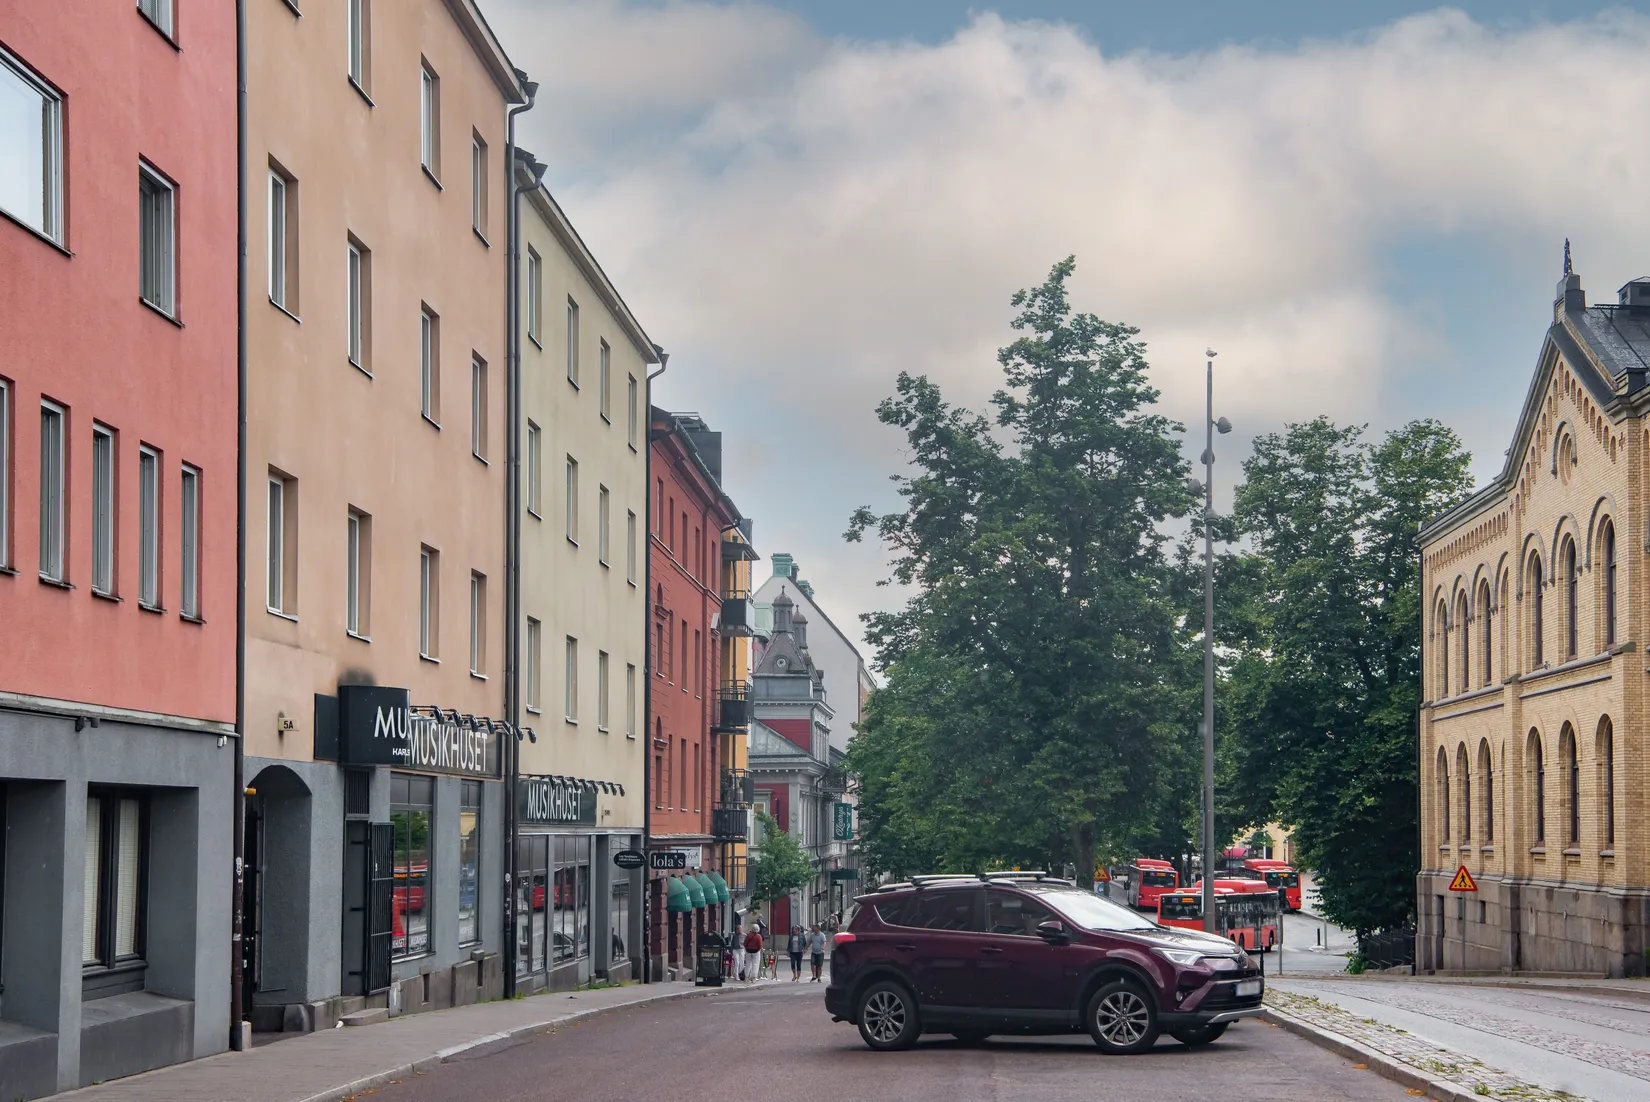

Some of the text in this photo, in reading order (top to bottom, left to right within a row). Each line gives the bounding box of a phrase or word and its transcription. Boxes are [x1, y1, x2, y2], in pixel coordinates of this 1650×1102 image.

[283, 721, 294, 730] 5A
[374, 705, 410, 739] MU
[409, 719, 488, 772] MUSIKHUSET
[527, 783, 582, 821] MUSIKHUSET
[653, 854, 684, 867] lola's
